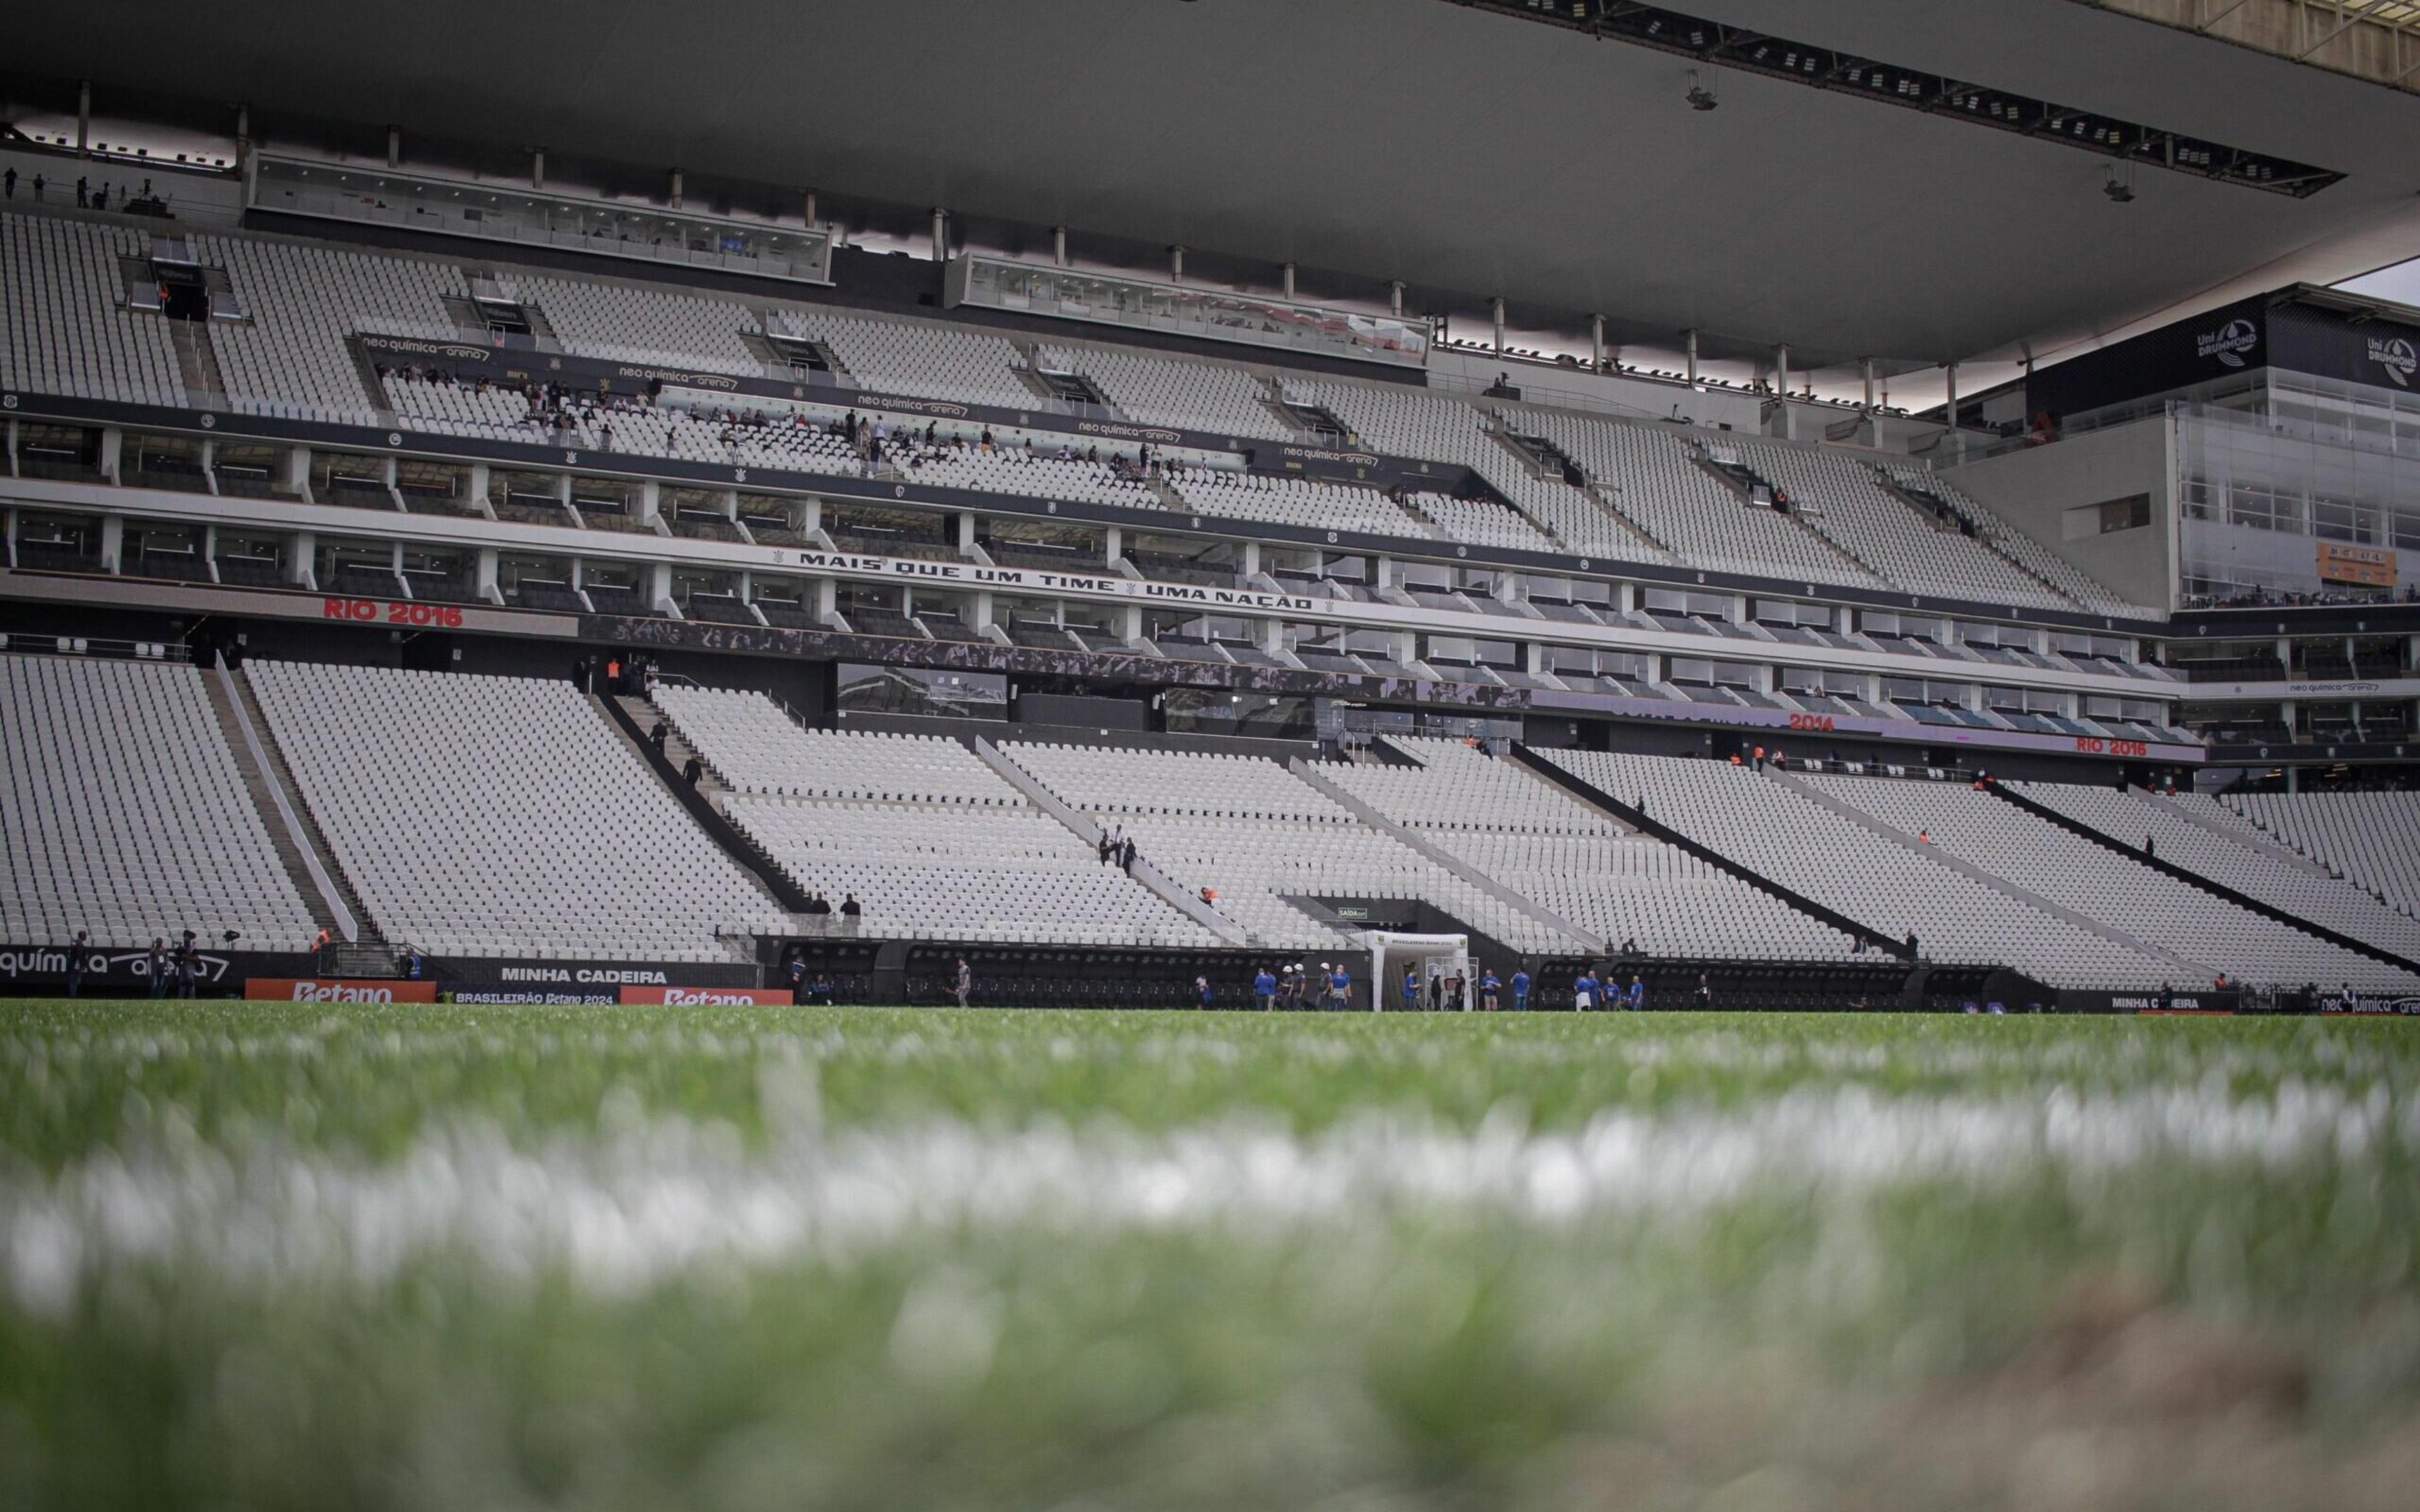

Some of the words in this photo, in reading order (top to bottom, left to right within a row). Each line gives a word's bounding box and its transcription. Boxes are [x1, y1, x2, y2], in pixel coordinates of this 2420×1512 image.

[362, 337, 388, 347] neo
[389, 340, 437, 353] química
[446, 348, 481, 359] arena
[2198, 332, 2215, 346] Uni
[2199, 333, 2257, 357] DRUMMOND
[2368, 338, 2382, 350] Uni
[2368, 350, 2416, 367] DRUMMOND
[619, 367, 642, 377] neo
[644, 369, 689, 382] química
[697, 377, 730, 387] arena
[858, 396, 880, 405] neo
[882, 398, 923, 410] química
[930, 405, 960, 415] arena
[1079, 423, 1099, 432] neo
[1100, 425, 1139, 436] química
[1146, 432, 1173, 441] arena
[1284, 447, 1303, 456] neo
[1304, 449, 1340, 461] química
[1346, 456, 1372, 465] arena
[800, 553, 882, 570] MAIS
[896, 562, 960, 578] QUE
[976, 570, 1022, 583] UM
[1039, 575, 1115, 592] TIME
[1146, 585, 1207, 600] UMA
[1215, 591, 1312, 609] NAÇÃO
[324, 598, 377, 621] RIO
[388, 606, 463, 627] 2016
[1789, 713, 1835, 732] 2014
[2077, 737, 2104, 753] RIO
[2109, 740, 2147, 757] 2016
[0, 948, 108, 977] químa
[502, 968, 572, 982] MINHA
[576, 970, 667, 984] CADEIRA
[292, 982, 392, 1004] Betano
[456, 992, 543, 1004] BRASILEIRÃO
[546, 993, 581, 1005] Betano
[584, 995, 613, 1005] 2024
[664, 989, 754, 1006] Betano
[2112, 998, 2148, 1008] MINHA
[2151, 998, 2199, 1008] CEIRA
[2400, 1003, 2420, 1013] are
